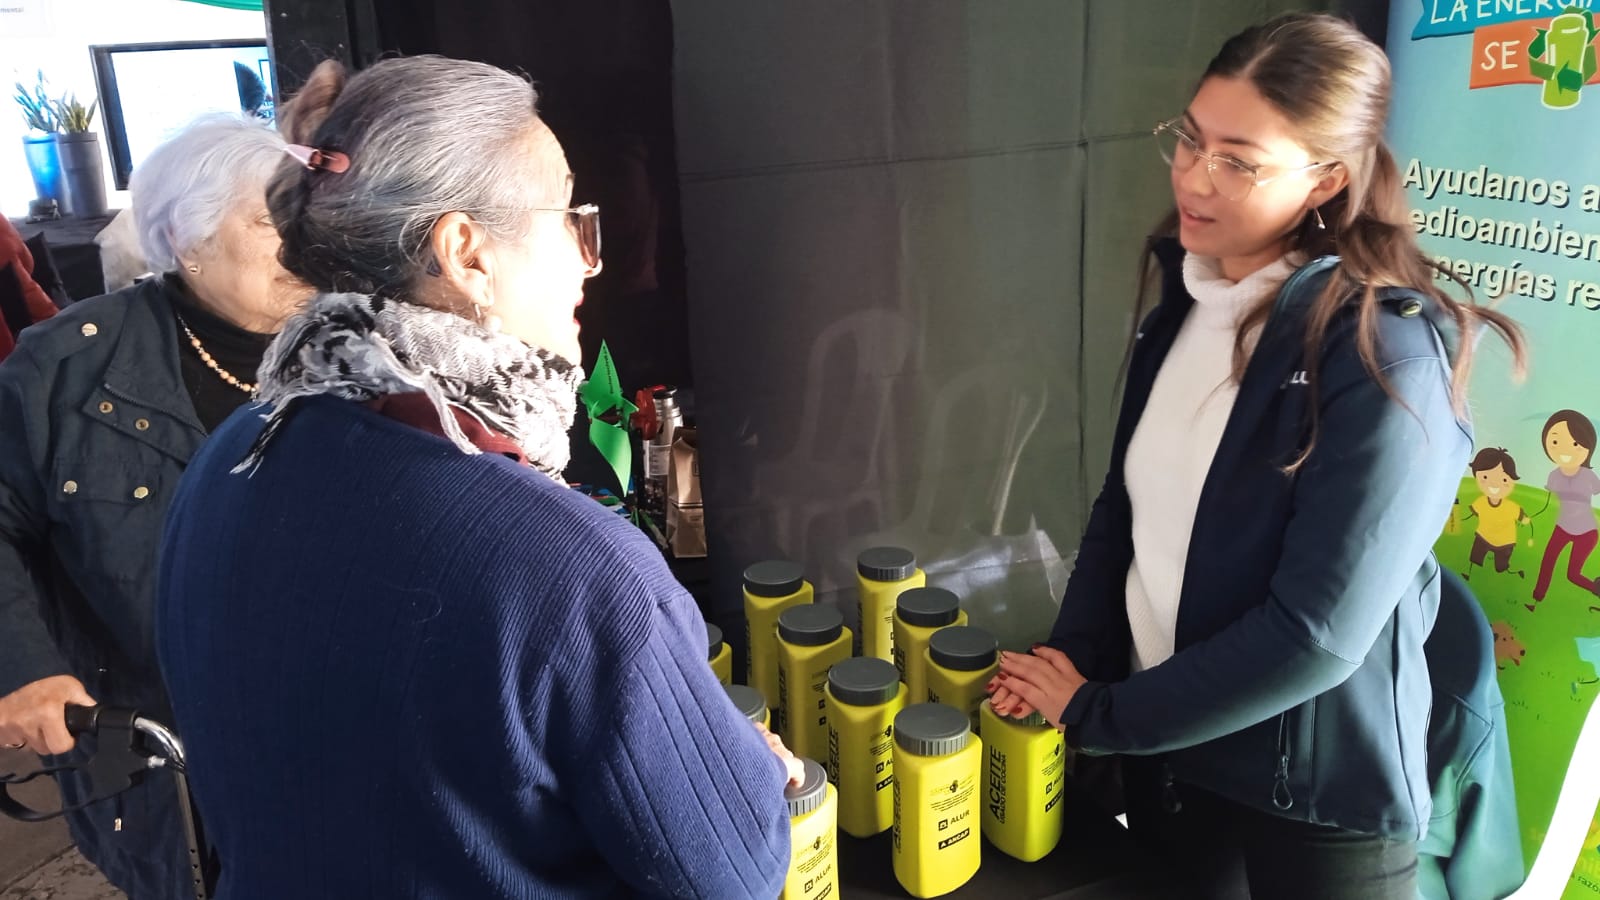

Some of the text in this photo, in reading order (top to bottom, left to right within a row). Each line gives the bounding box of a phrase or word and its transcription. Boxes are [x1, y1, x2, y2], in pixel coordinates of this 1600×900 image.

[1481, 40, 1520, 71] SE
[1402, 157, 1570, 208] Ayudanos
[1408, 205, 1600, 263] edioambien
[1430, 254, 1556, 302] nergías
[988, 745, 1001, 820] ACEITE
[950, 809, 970, 825] ALUR
